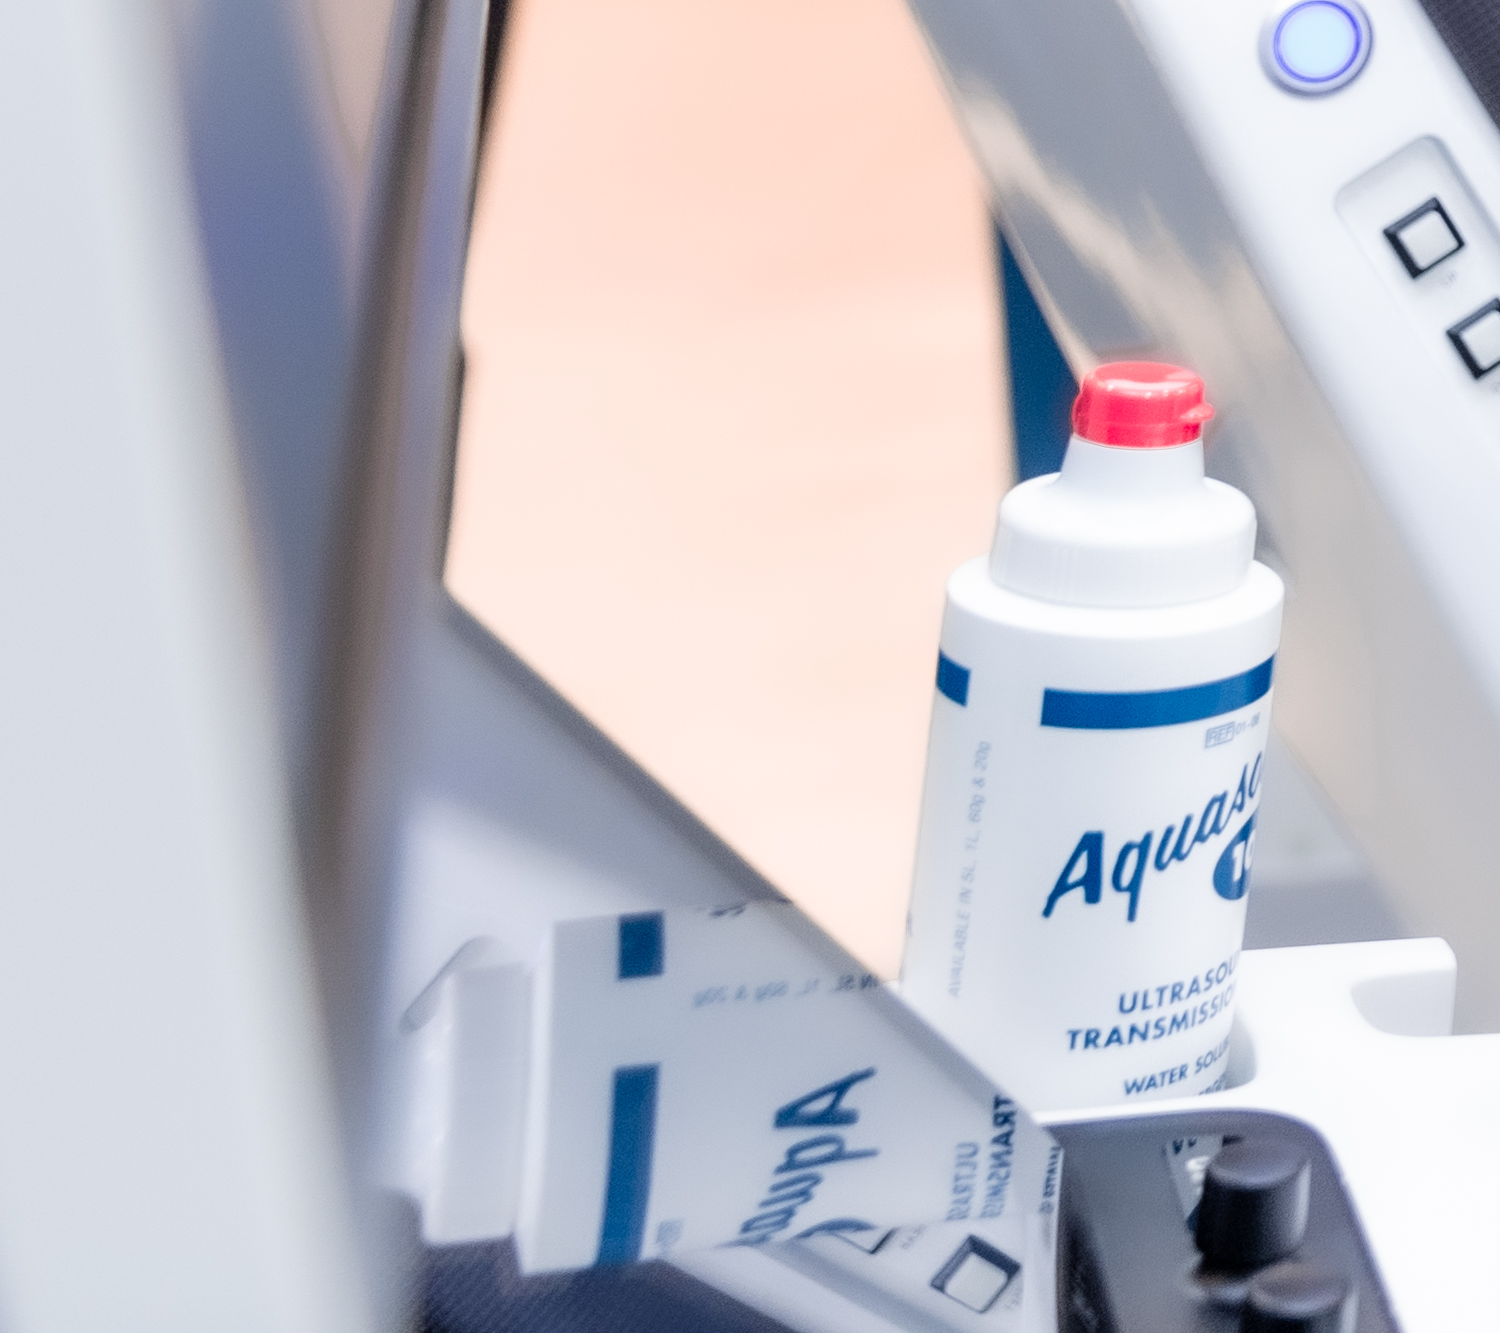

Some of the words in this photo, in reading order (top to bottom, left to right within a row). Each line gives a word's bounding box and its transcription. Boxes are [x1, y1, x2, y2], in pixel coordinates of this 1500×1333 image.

[970, 776, 986, 790] &
[957, 885, 974, 905] IN
[947, 910, 970, 999] AVAILABLE
[1123, 1062, 1189, 1096] WATER
